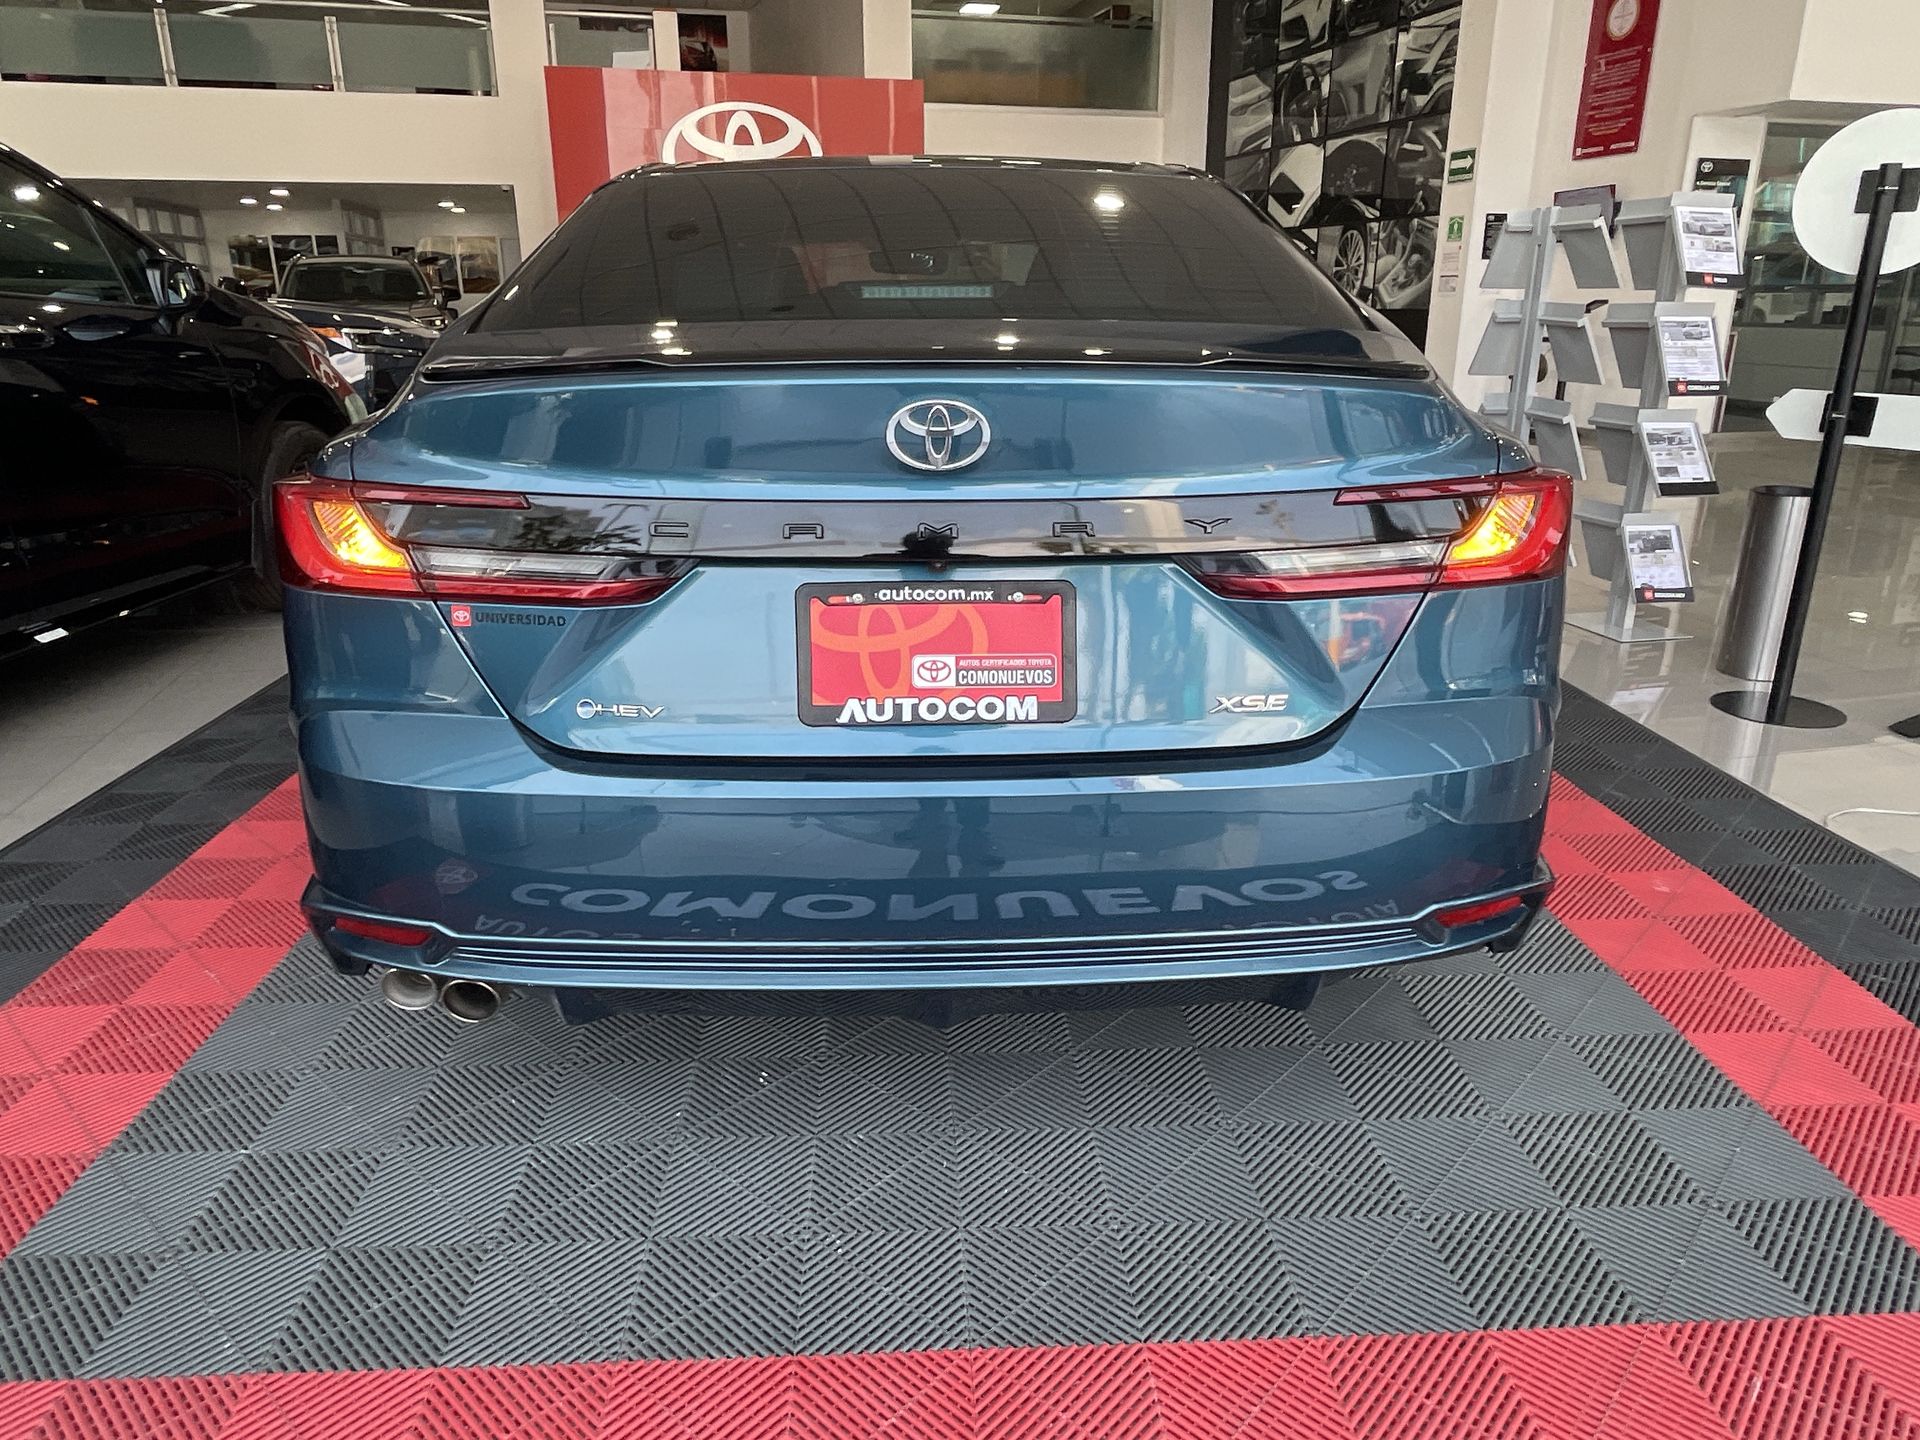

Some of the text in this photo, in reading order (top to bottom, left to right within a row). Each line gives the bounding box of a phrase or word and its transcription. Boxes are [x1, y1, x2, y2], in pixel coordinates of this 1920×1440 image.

[648, 517, 1233, 540] CAMRY
[878, 586, 994, 601] autocom.mx
[475, 611, 567, 627] UNIVERSIDAD
[958, 670, 1053, 684] COMONUEVOS
[836, 695, 1038, 723] AUTOCOM
[1209, 694, 1289, 714] XSE
